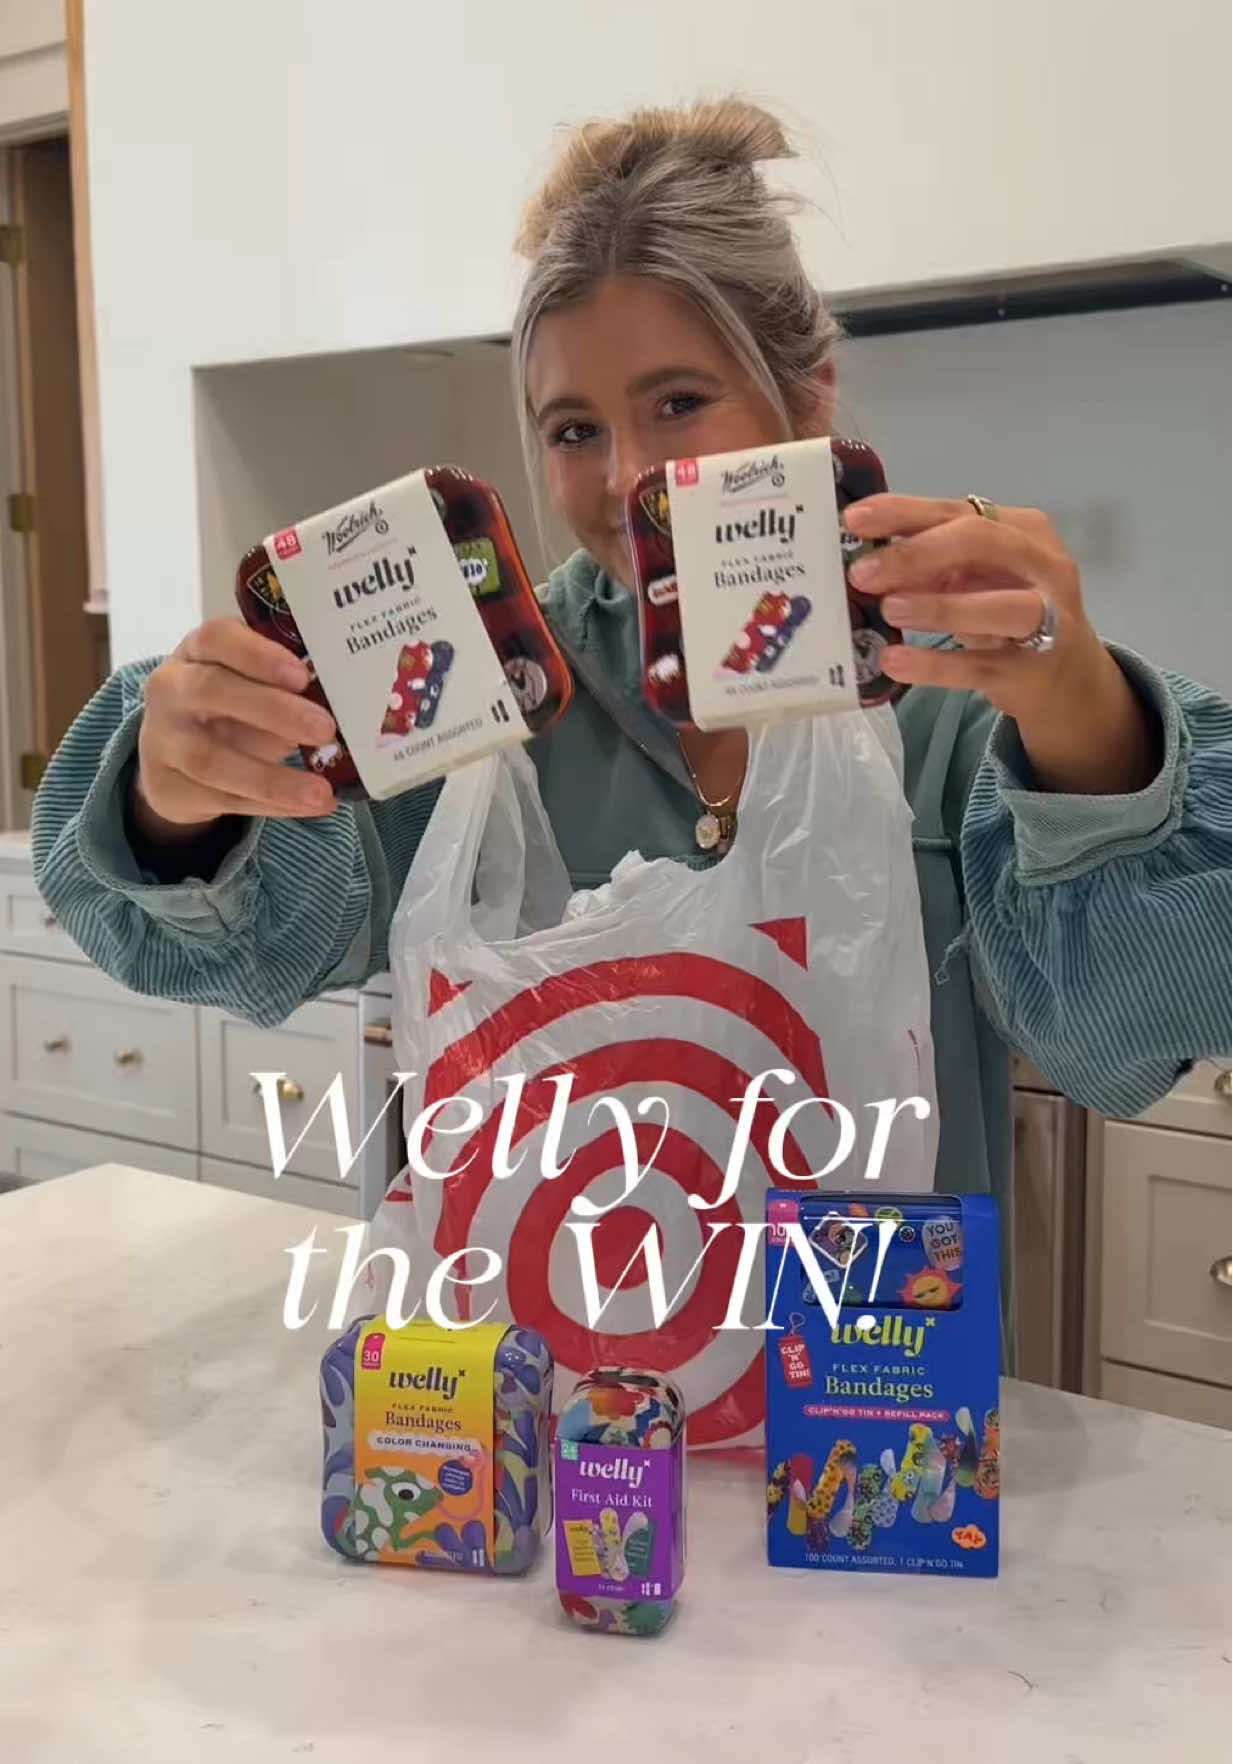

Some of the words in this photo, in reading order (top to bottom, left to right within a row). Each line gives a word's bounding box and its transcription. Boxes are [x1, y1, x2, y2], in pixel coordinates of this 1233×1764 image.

[715, 508, 796, 544] welly
[274, 534, 297, 551] 48
[334, 557, 414, 608] welly
[714, 564, 806, 589] Bandages
[346, 607, 438, 655] Bandages
[926, 1222, 954, 1237] YOU
[930, 1232, 958, 1249] GOT
[831, 1316, 925, 1358] welly
[364, 1351, 380, 1361] 30
[789, 1361, 804, 1370] GO
[833, 1363, 868, 1374] FLEX
[874, 1365, 926, 1376] FABRIC
[389, 1366, 458, 1400] welly
[826, 1376, 934, 1403] Bandages
[385, 1411, 462, 1433] Bandages
[859, 1408, 874, 1417] TIN
[376, 1436, 413, 1446] COLOR
[415, 1439, 472, 1452] CHANGING
[579, 1458, 644, 1488] welly
[571, 1488, 600, 1505] First
[605, 1493, 629, 1507] Aid
[632, 1494, 653, 1507] Kit
[804, 1553, 819, 1563] 100
[821, 1553, 849, 1564] COUNT
